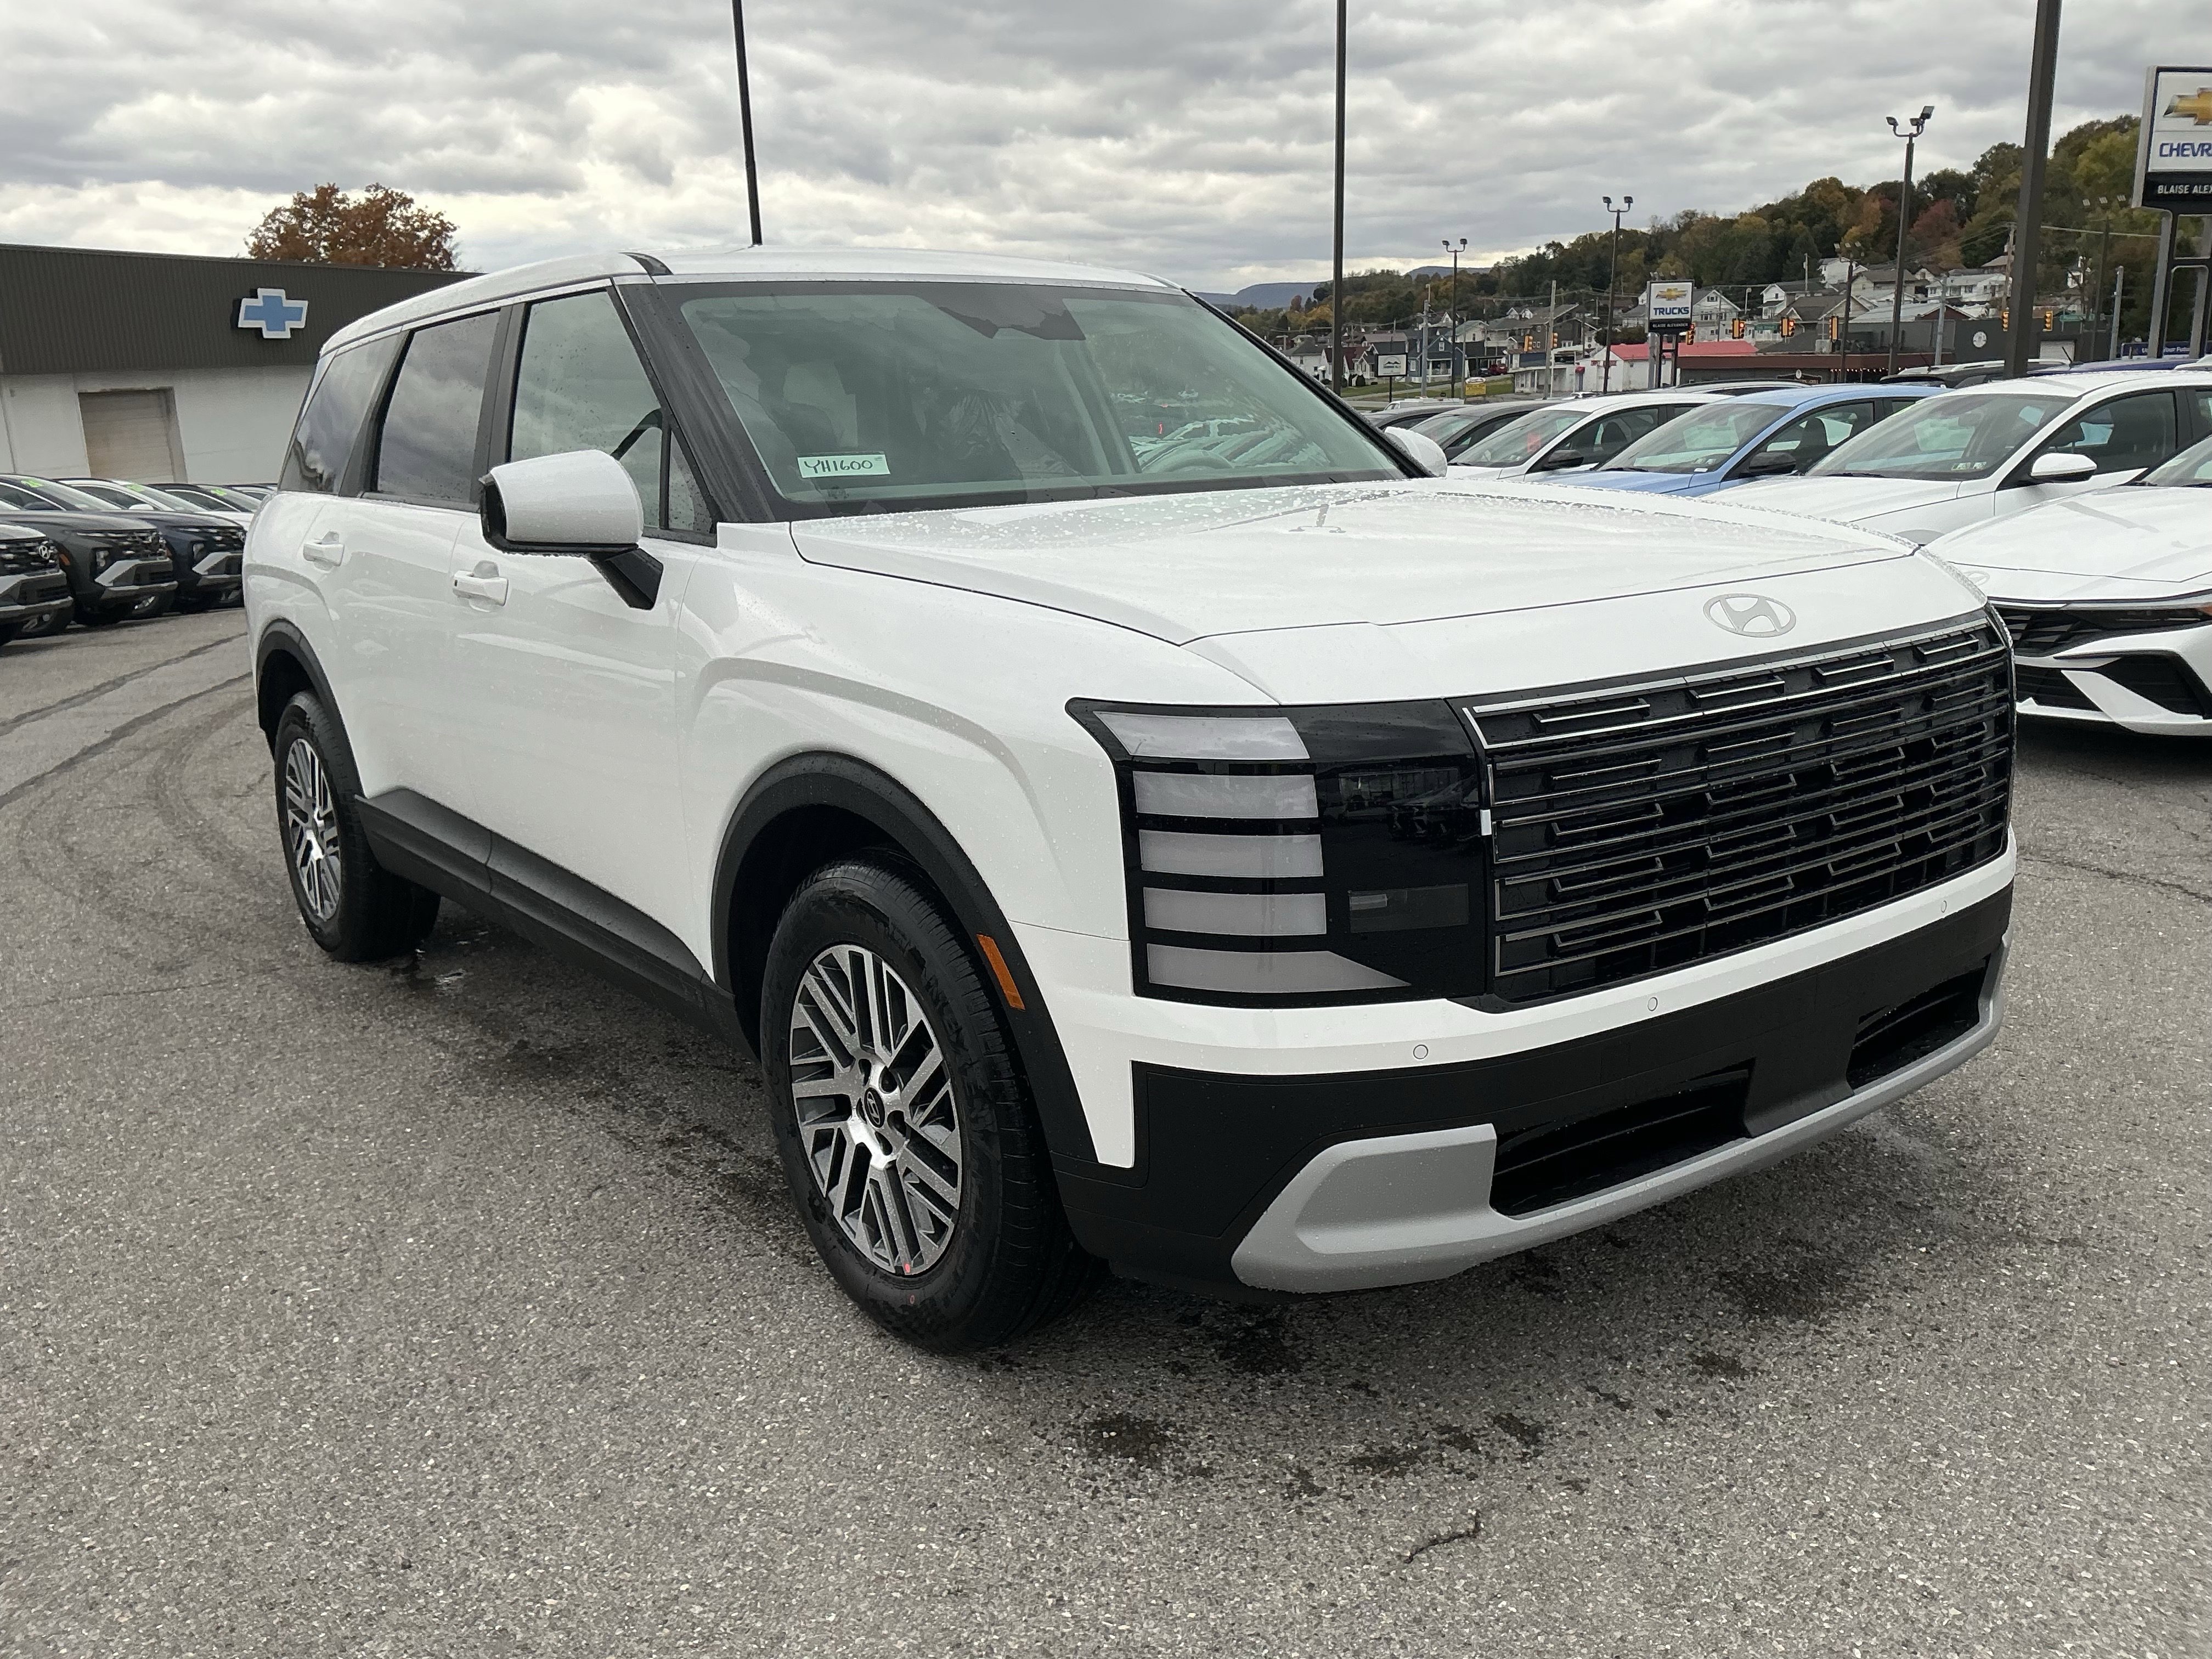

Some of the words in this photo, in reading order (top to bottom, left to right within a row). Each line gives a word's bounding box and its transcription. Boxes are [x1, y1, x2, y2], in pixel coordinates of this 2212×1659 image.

[2158, 184, 2190, 194] BLAISE
[1654, 307, 1690, 315] TRUCKS
[804, 459, 873, 474] YH1600
